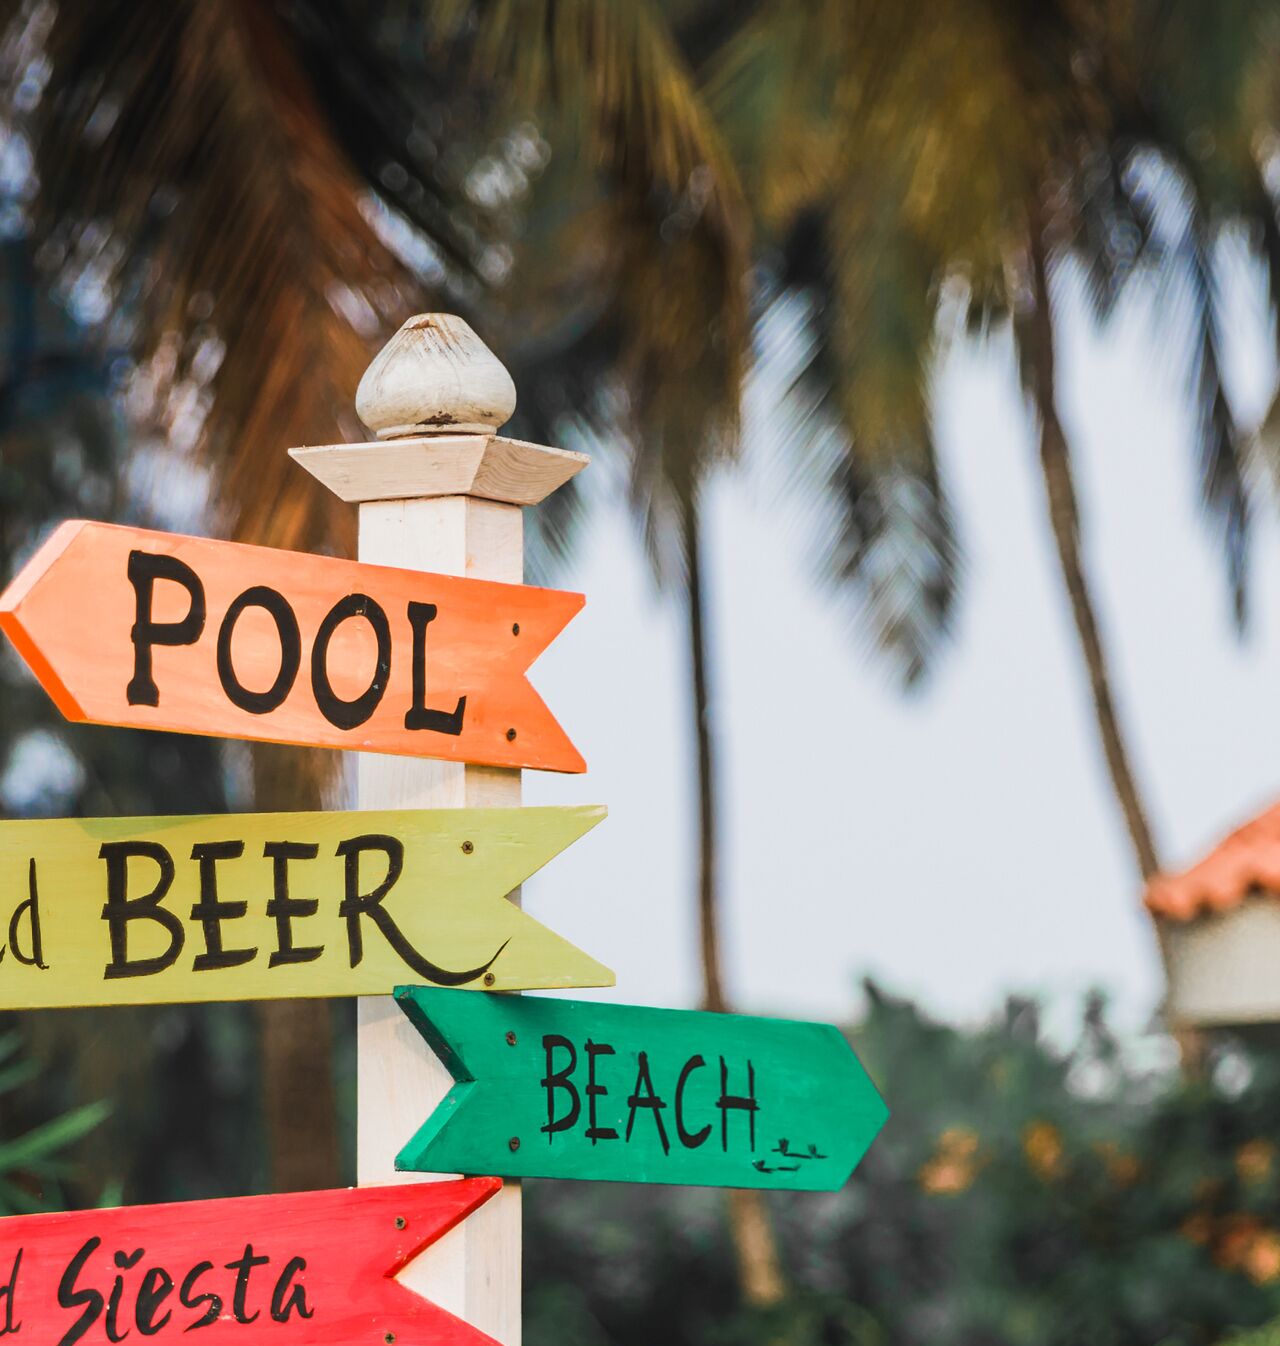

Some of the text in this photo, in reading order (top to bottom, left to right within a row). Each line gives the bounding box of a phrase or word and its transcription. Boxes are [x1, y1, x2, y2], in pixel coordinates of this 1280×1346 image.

[125, 549, 468, 732] POOL
[97, 833, 513, 987] BEER
[540, 1034, 761, 1157] BEACH
